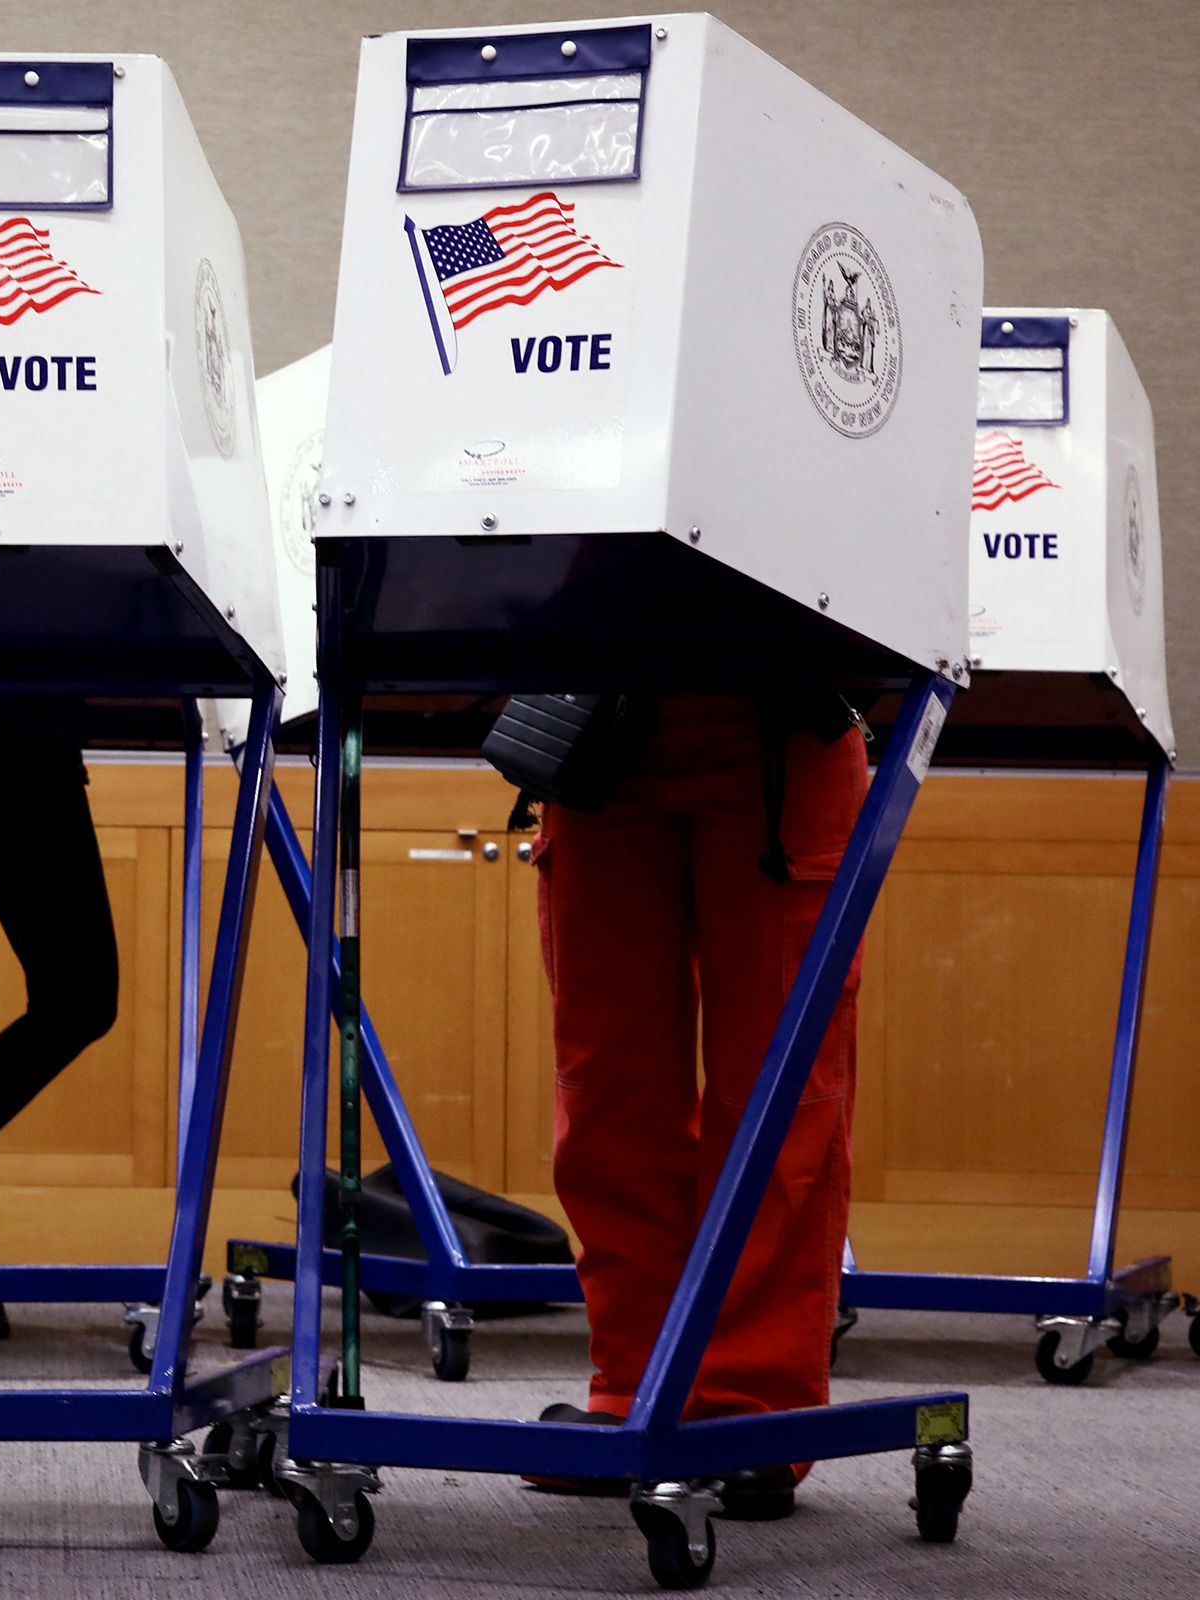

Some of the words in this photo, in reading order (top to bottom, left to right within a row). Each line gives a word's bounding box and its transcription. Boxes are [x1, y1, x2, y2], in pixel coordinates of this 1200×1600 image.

[801, 234, 832, 286] BOARD
[833, 231, 848, 248] OF
[850, 236, 896, 329] ELECTIONS
[510, 333, 612, 374] VOTE
[814, 382, 841, 418] CITY
[841, 410, 857, 428] OF
[983, 533, 1059, 560] VOTE
